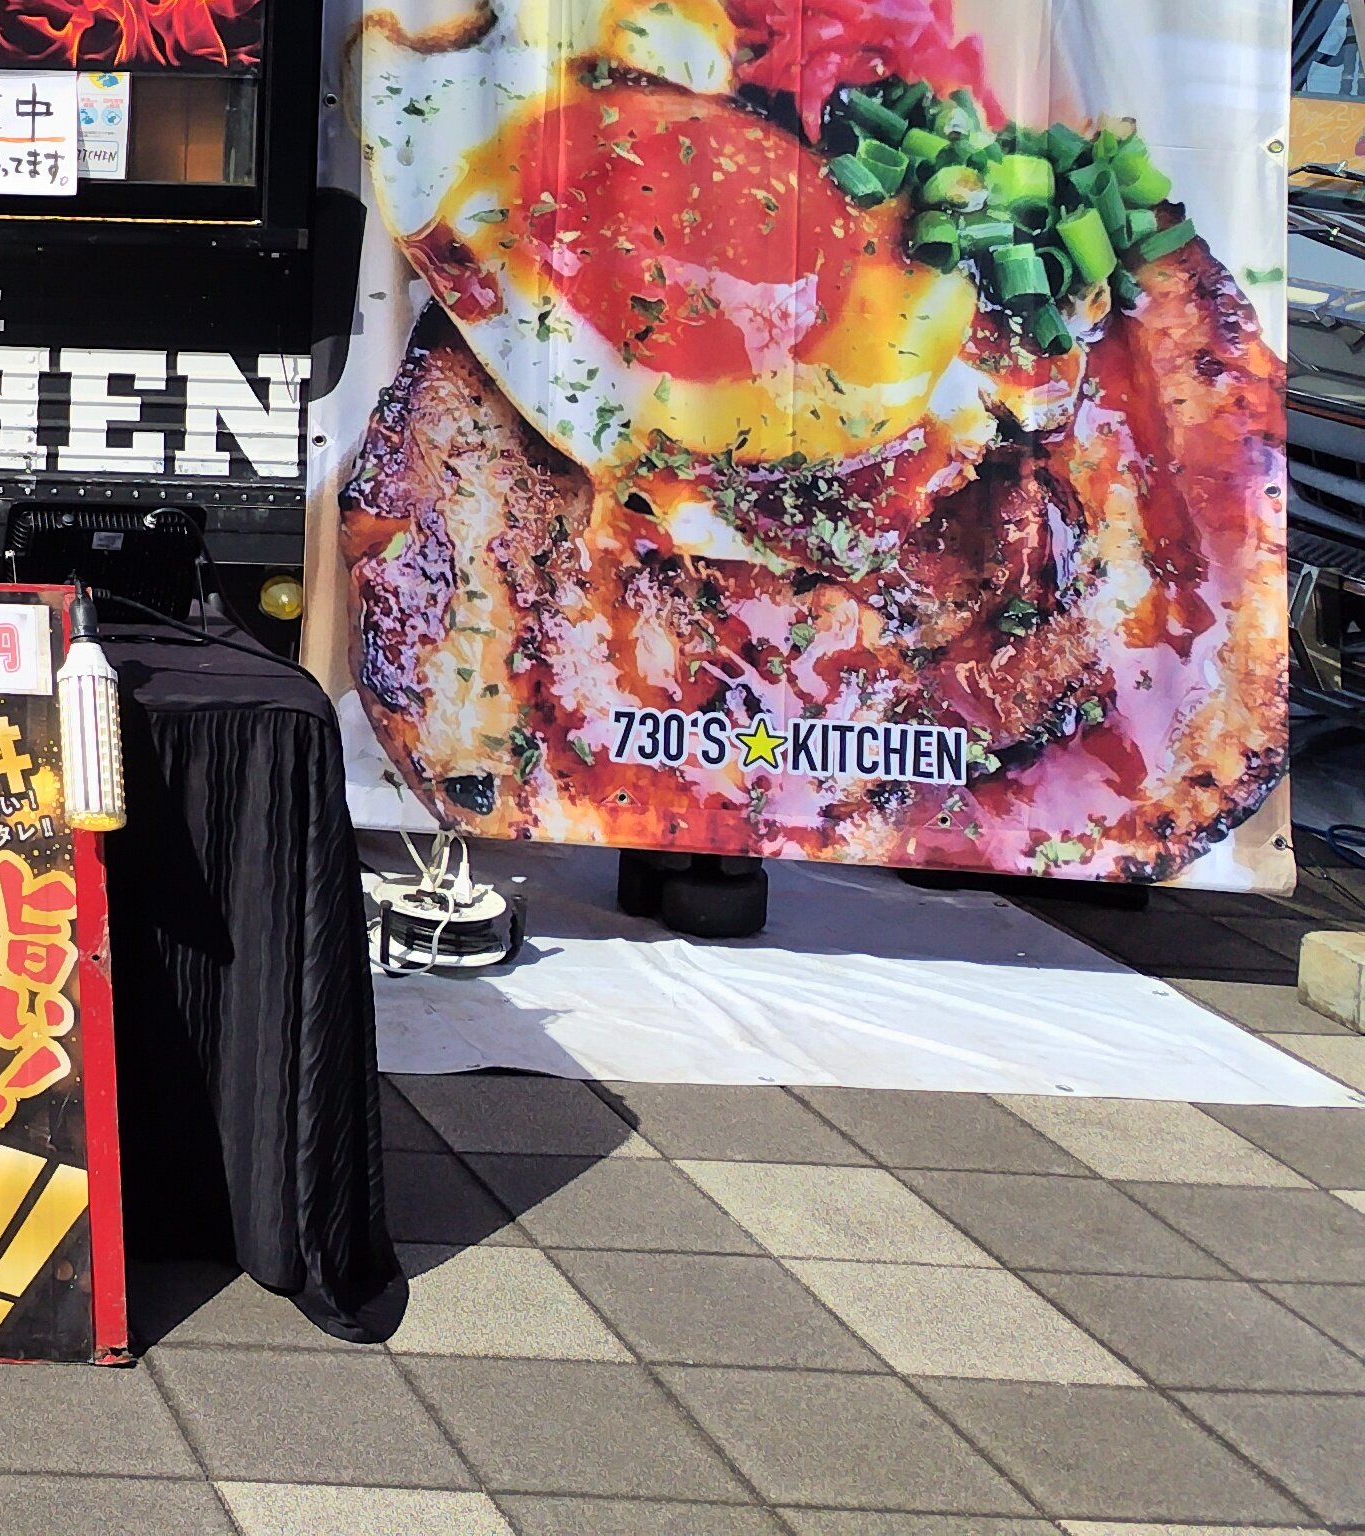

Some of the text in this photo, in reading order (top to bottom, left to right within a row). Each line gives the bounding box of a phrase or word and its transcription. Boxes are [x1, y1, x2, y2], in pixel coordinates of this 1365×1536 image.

[77, 148, 118, 163] ITCHEN
[612, 710, 966, 781] 730'S KITCHEN
